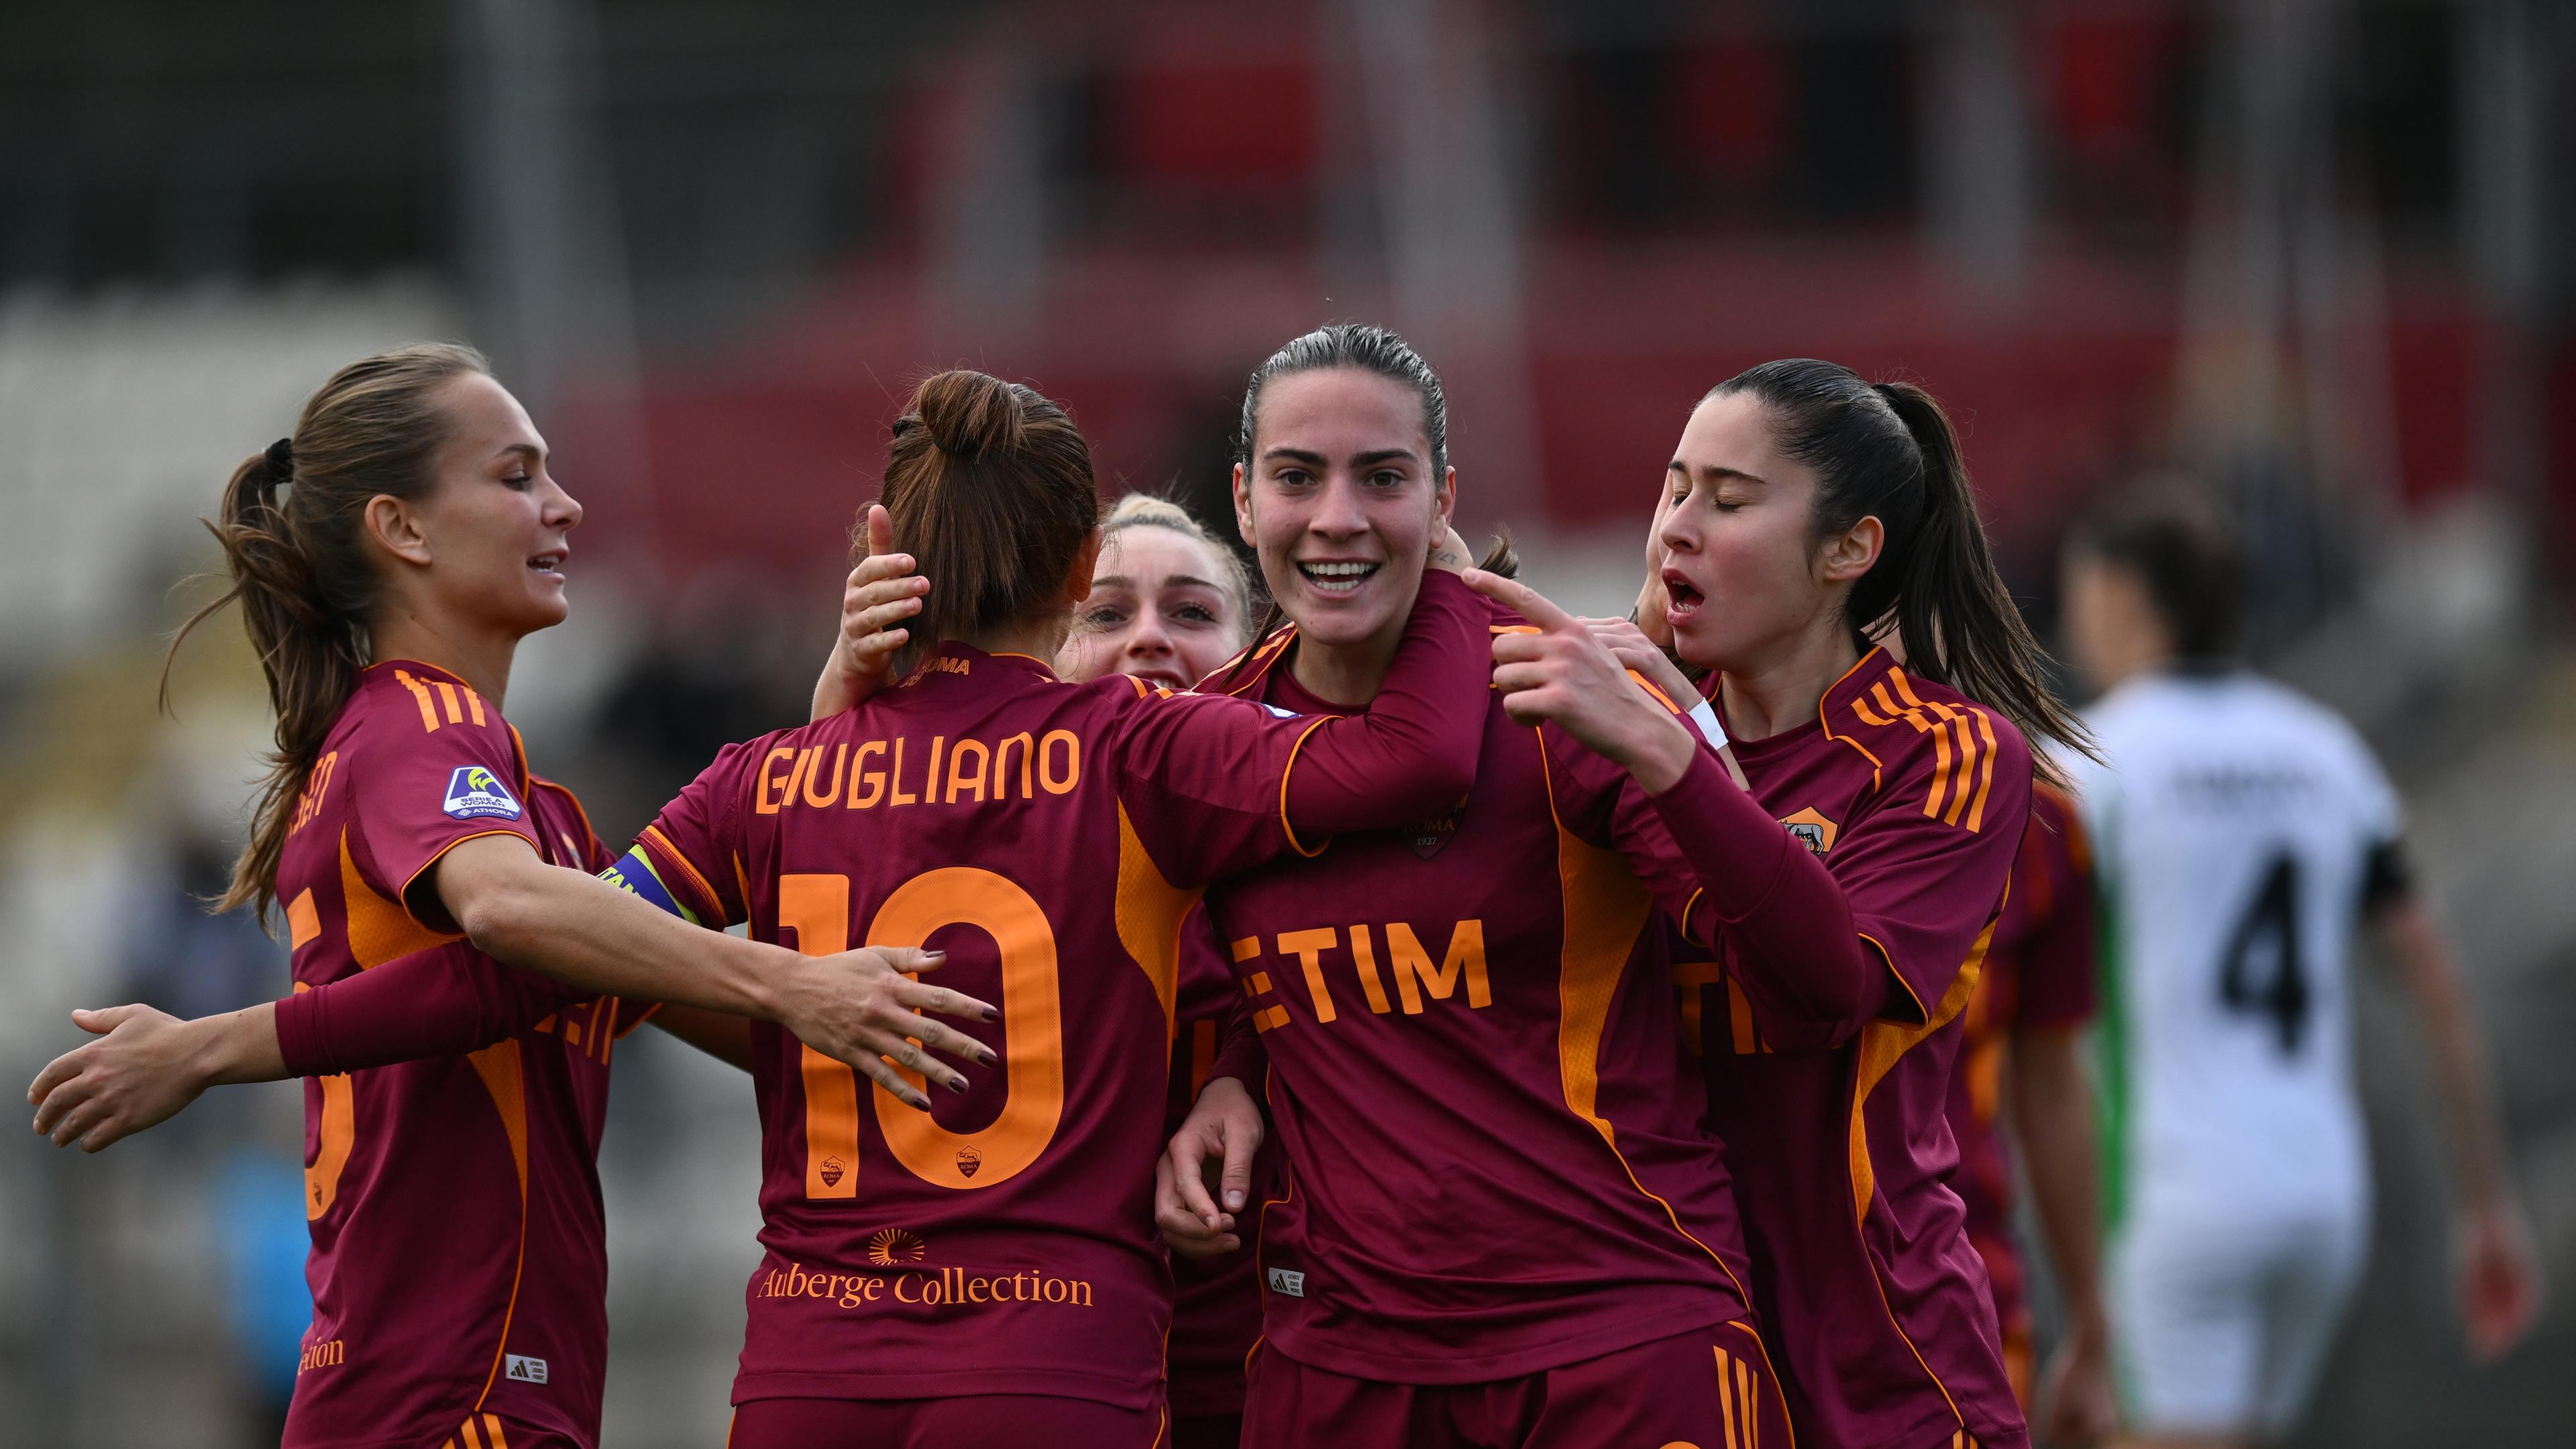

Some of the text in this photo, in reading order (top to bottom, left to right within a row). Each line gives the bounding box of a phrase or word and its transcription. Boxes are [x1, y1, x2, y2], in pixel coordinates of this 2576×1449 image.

[755, 729, 1081, 814] GIUGLIANO
[473, 808, 514, 817] ATHORA
[1416, 837, 1438, 846] 1927
[2212, 847, 2311, 1057] 4
[779, 867, 1064, 1199] 10
[756, 1263, 1094, 1309] Auberge Collection
